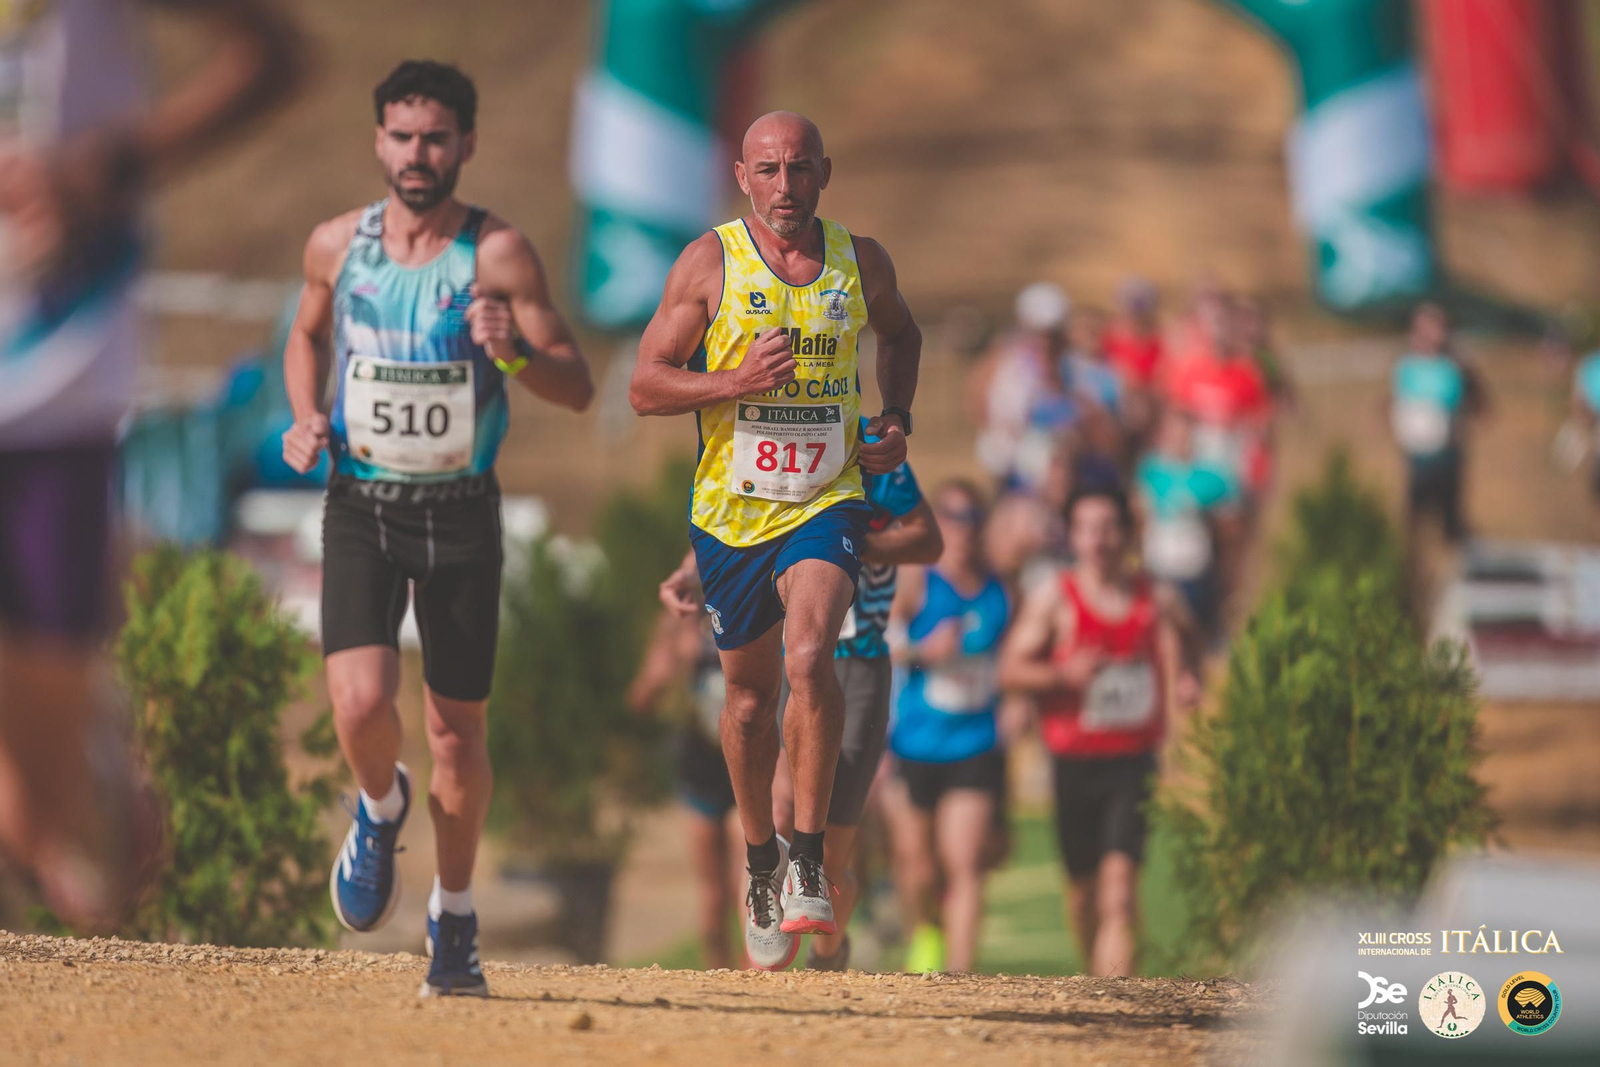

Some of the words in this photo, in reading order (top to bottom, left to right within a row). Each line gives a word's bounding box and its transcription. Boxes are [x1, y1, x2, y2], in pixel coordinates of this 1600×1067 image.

[780, 328, 837, 355] Mafia
[806, 374, 848, 398] CÁDIZ
[372, 401, 450, 438] 510
[768, 408, 819, 421] ITÁLICA
[756, 441, 827, 474] 817
